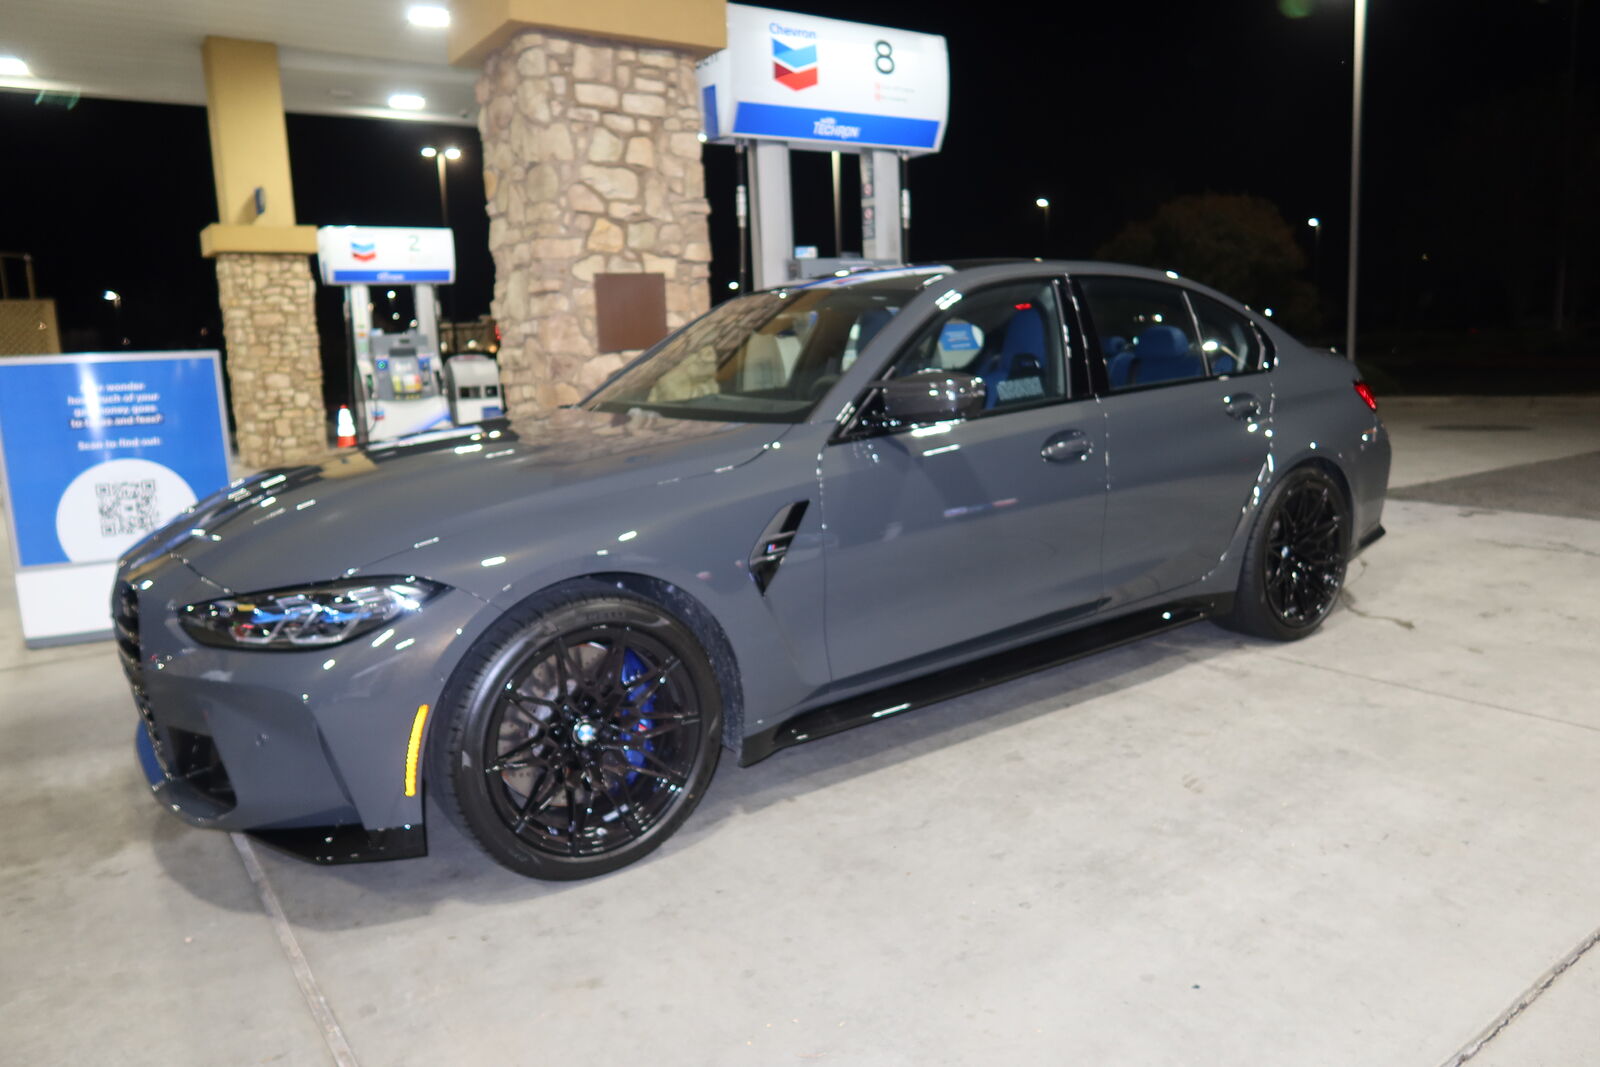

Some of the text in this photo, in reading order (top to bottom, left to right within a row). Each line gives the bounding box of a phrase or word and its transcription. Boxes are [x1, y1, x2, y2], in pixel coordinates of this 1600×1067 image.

[769, 23, 816, 38] Chevron
[875, 40, 894, 74] 8
[408, 235, 420, 251] 2
[115, 417, 134, 425] and
